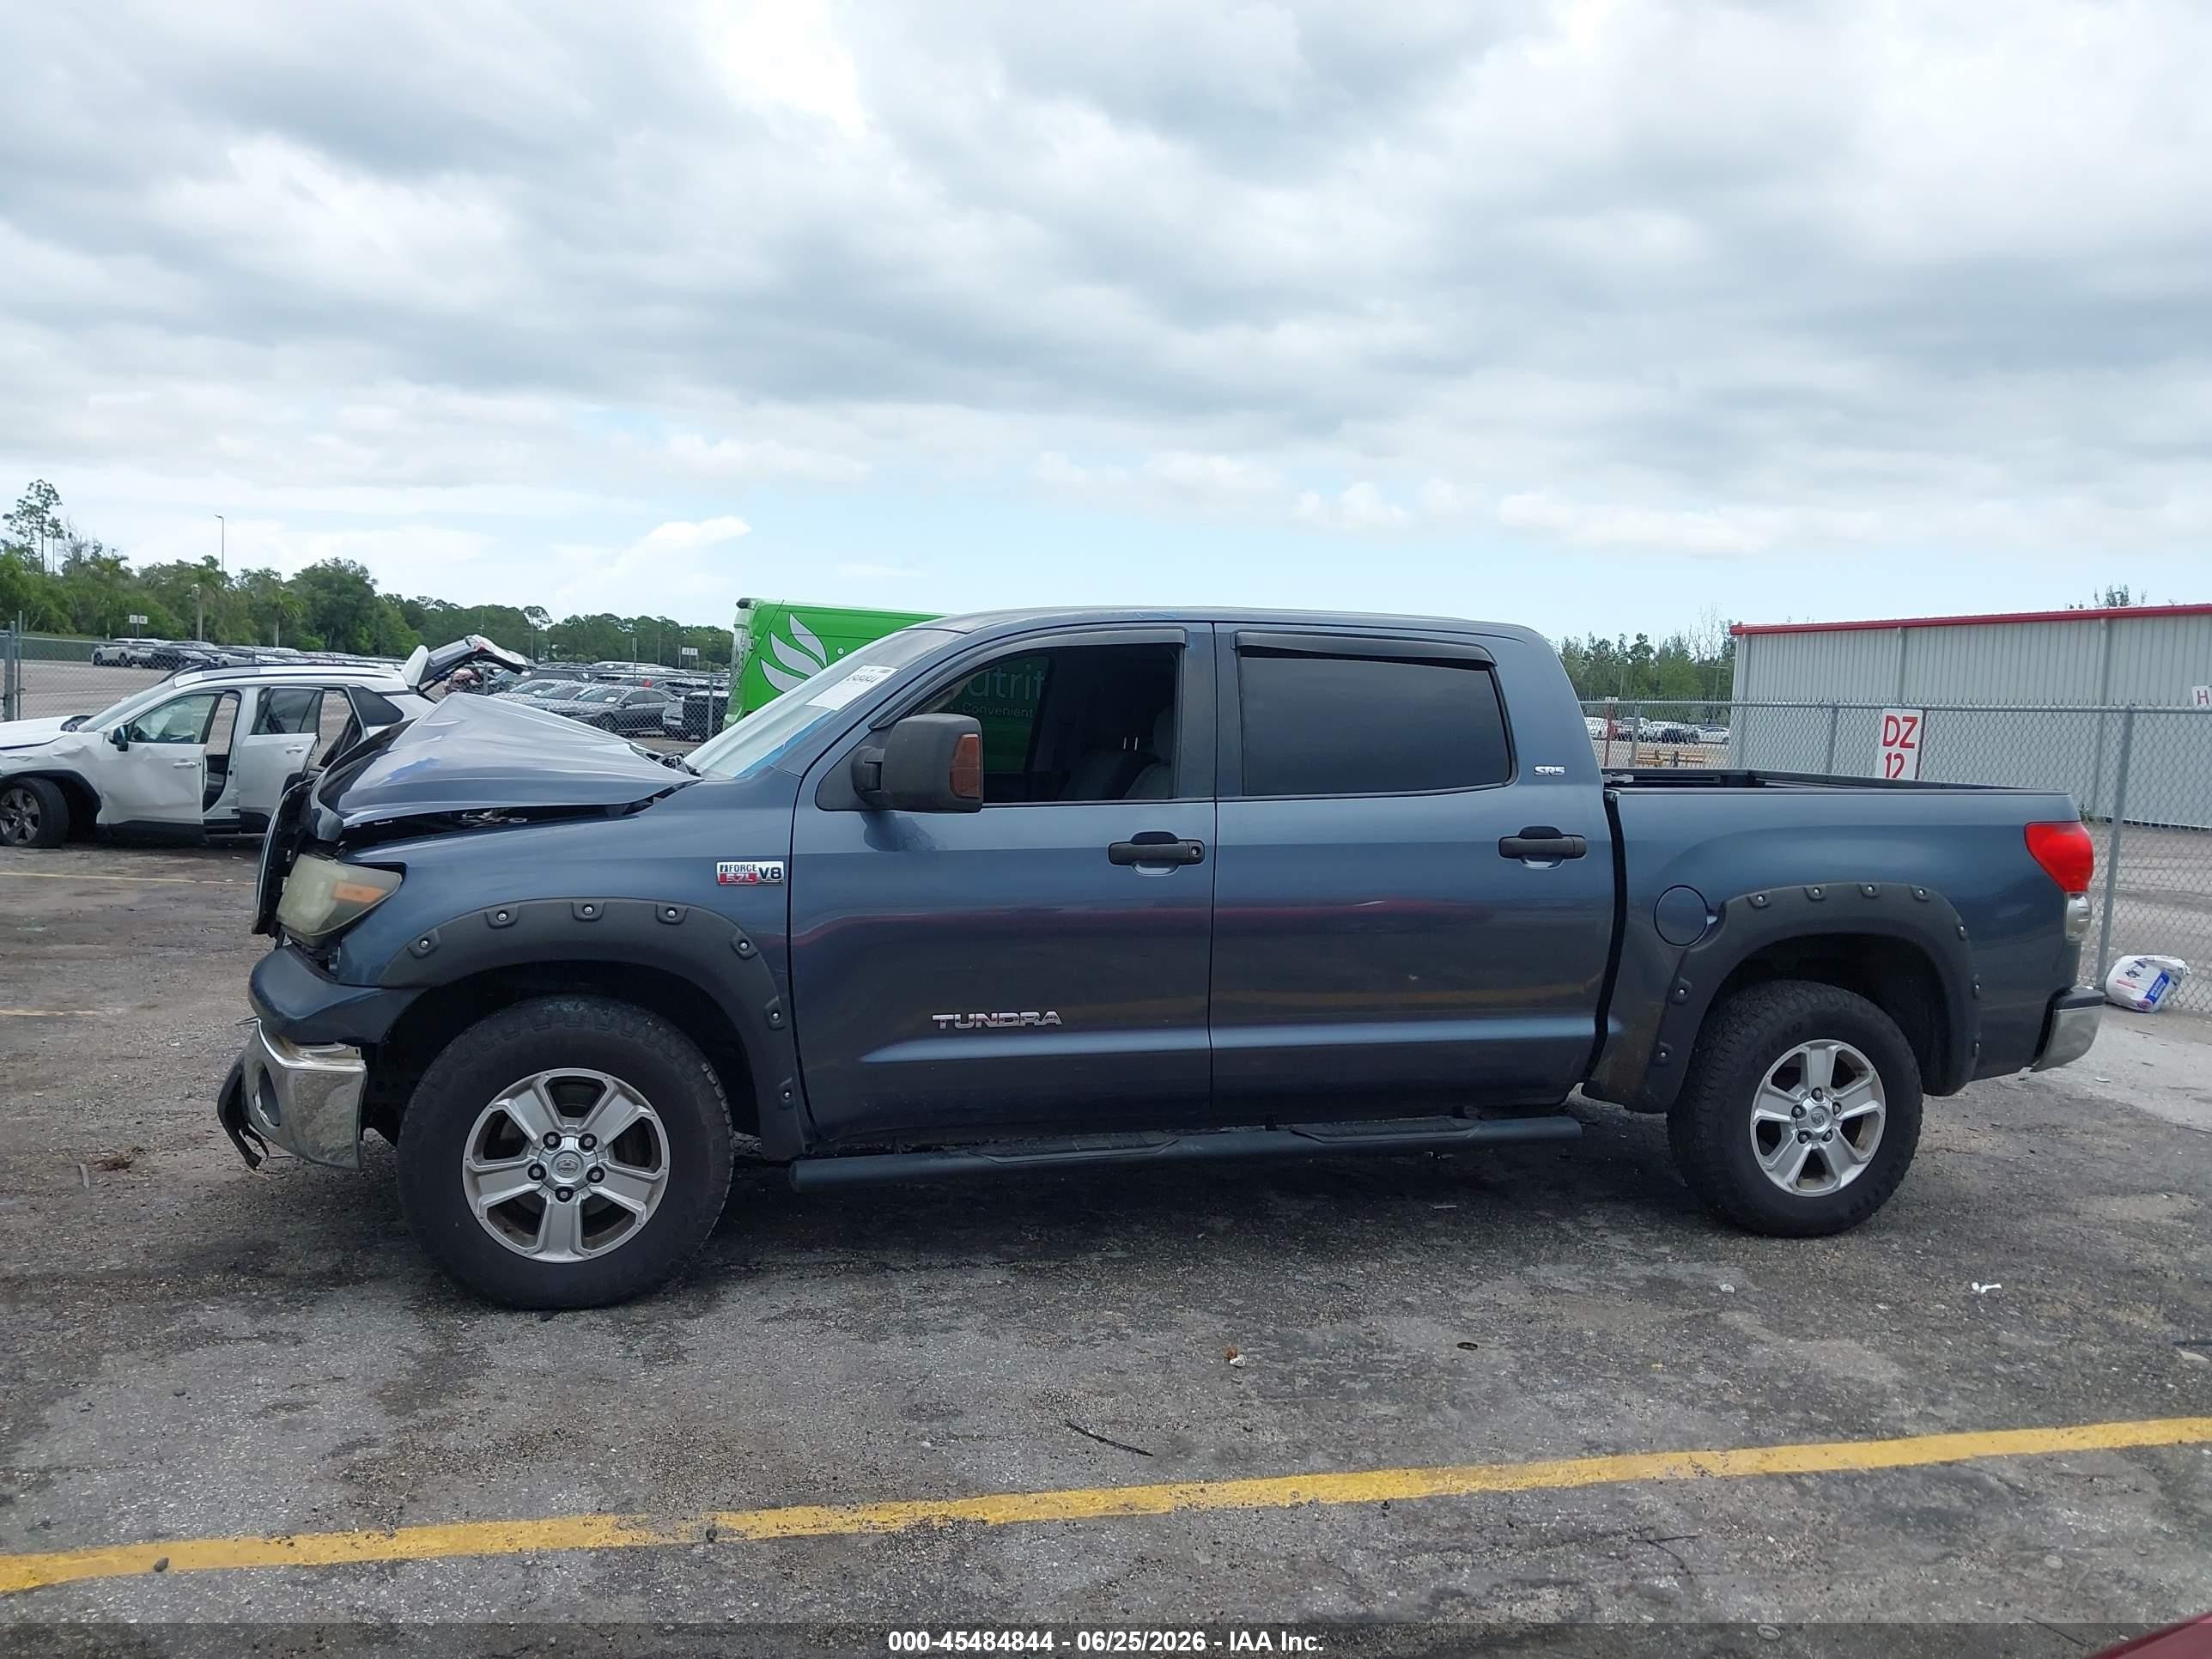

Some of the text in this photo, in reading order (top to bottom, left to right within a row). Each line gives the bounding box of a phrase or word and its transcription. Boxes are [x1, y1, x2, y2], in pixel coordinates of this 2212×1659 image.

[1882, 715, 1918, 749] DZ
[1886, 752, 1905, 779] 12
[758, 866, 782, 880] V8
[932, 1011, 1062, 1030] TUNDRA
